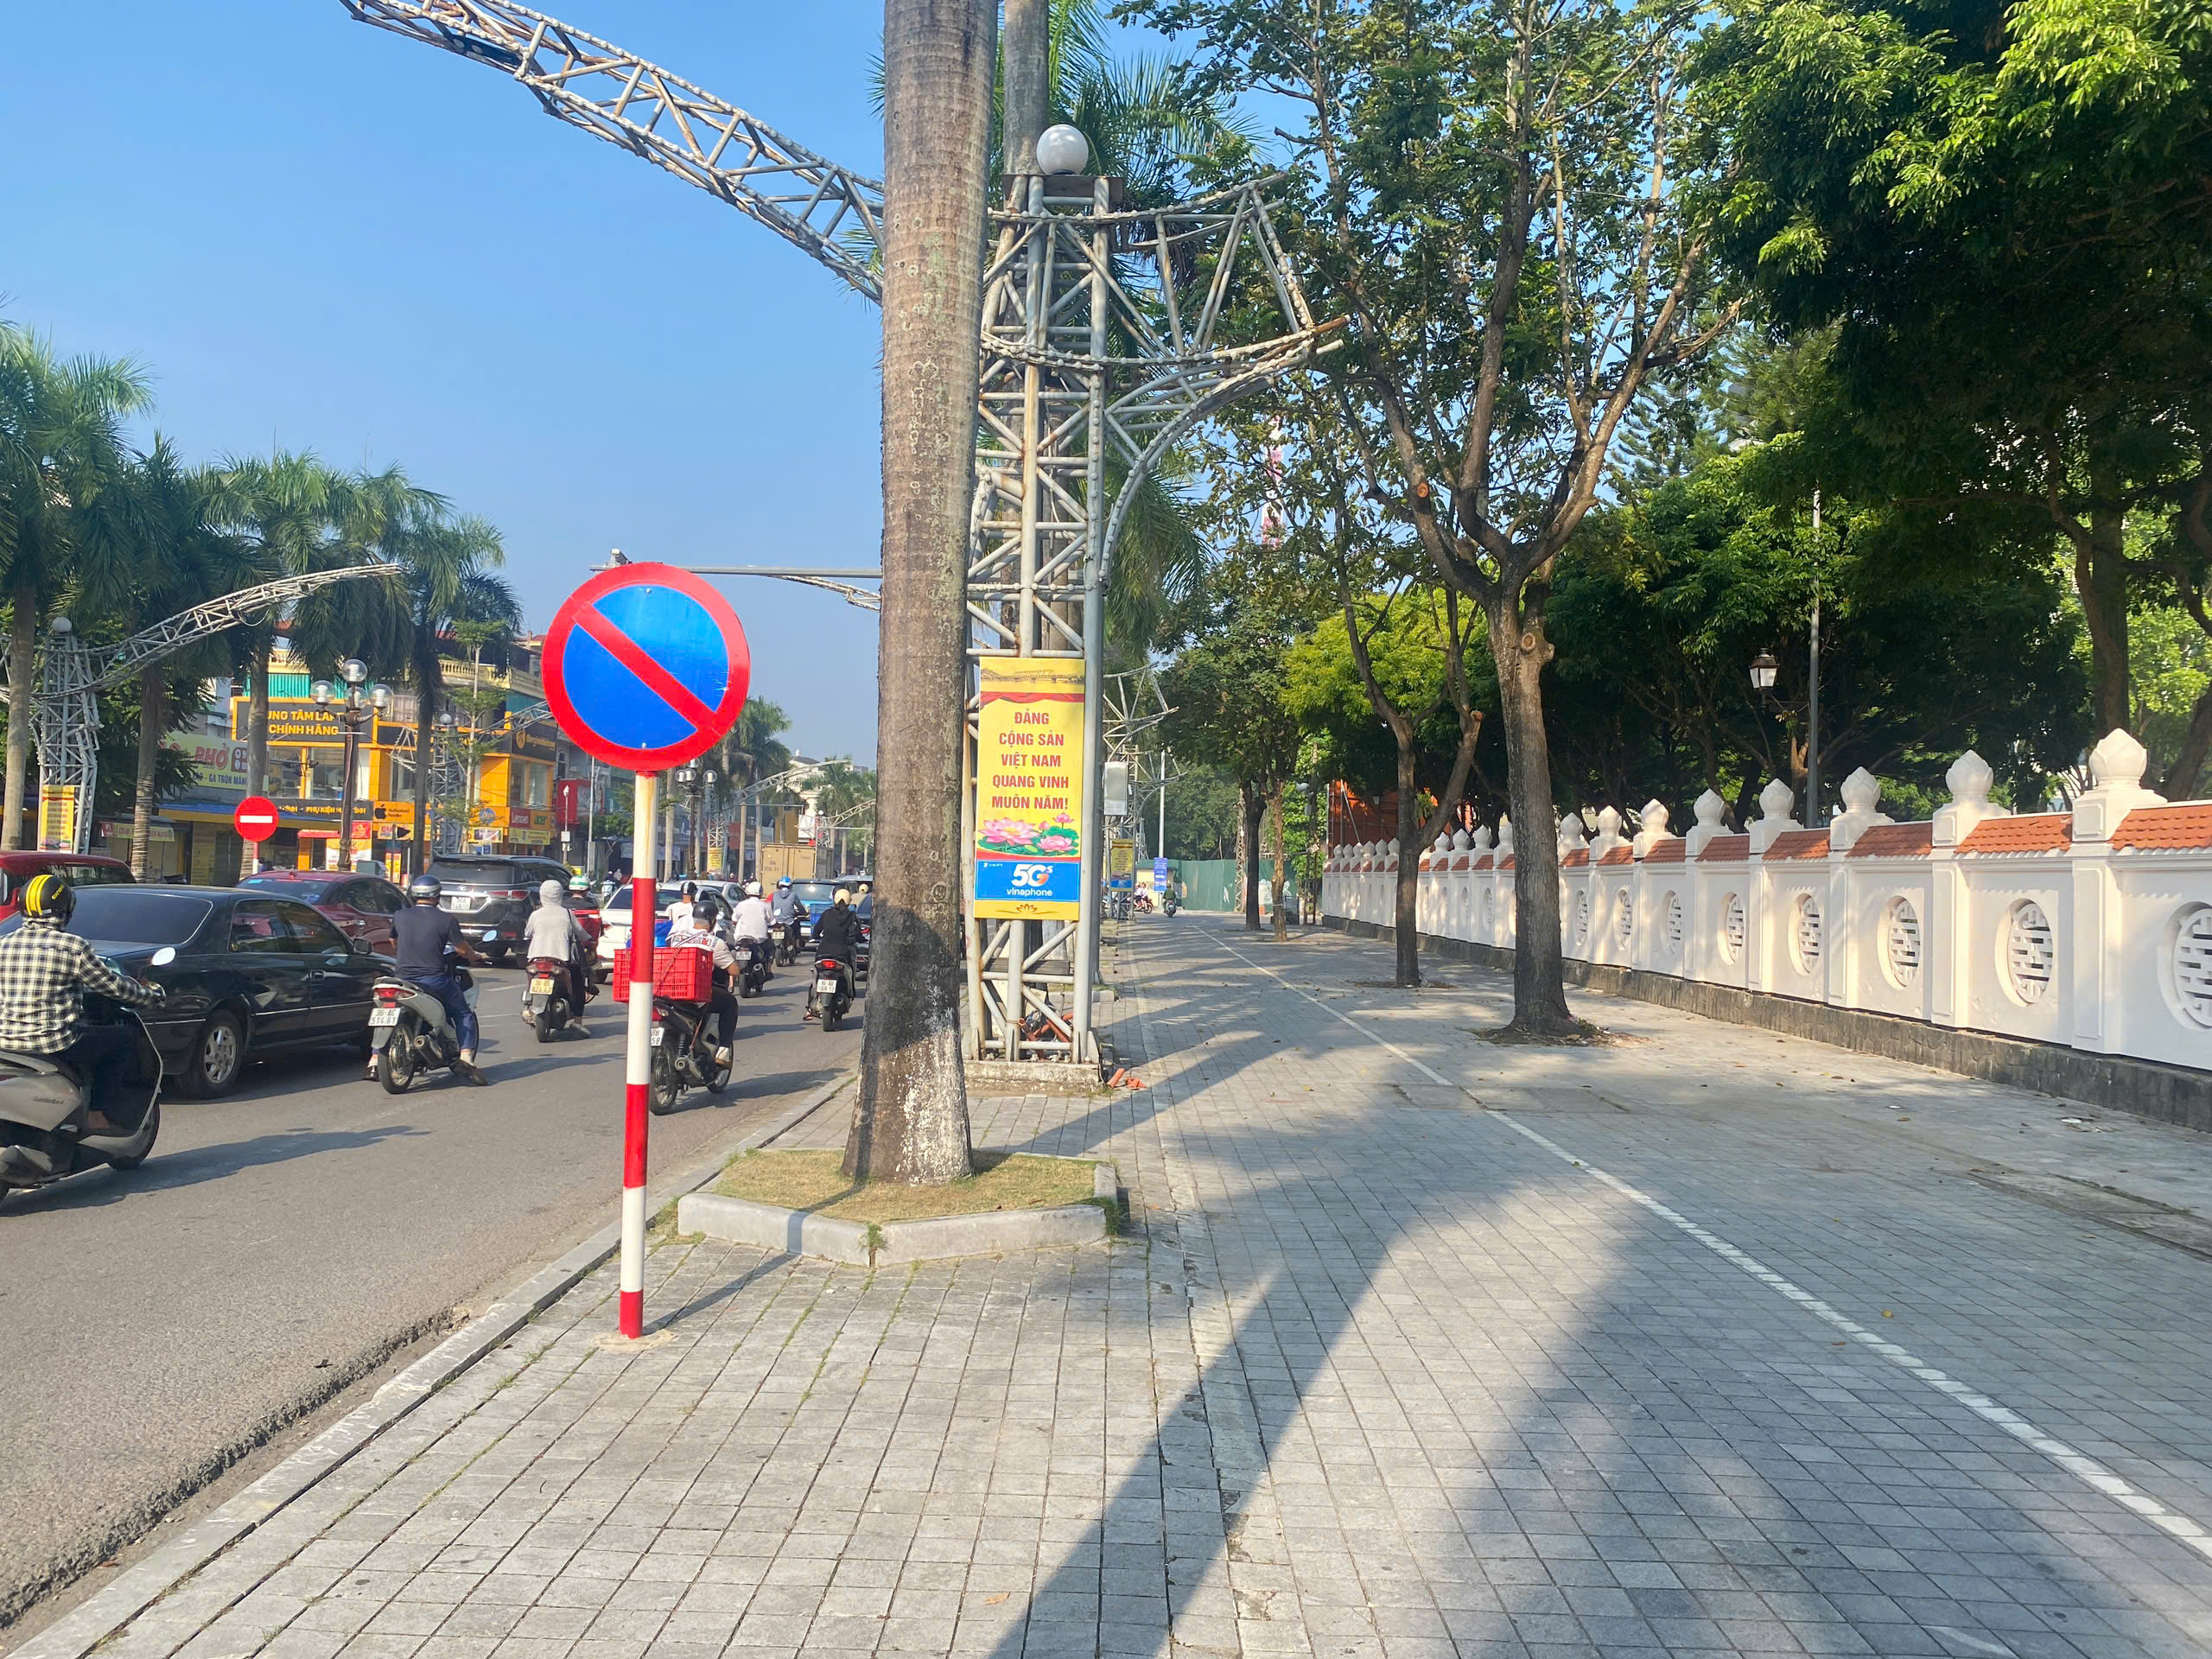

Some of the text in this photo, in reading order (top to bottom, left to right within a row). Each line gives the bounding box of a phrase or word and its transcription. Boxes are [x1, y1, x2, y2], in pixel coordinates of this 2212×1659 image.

[290, 709, 314, 721] TÂM
[1014, 708, 1050, 725] ĐẢNG
[269, 722, 340, 735] CHÍNH HÃNG
[999, 729, 1065, 747] CỘNG SẢN
[1001, 752, 1061, 769] VIỆT NAM
[993, 774, 1069, 789] QUANG VINH
[991, 793, 1069, 810] MUÔN NĂM!
[512, 812, 529, 824] Lenovo
[1007, 887, 1053, 897] vinaphone
